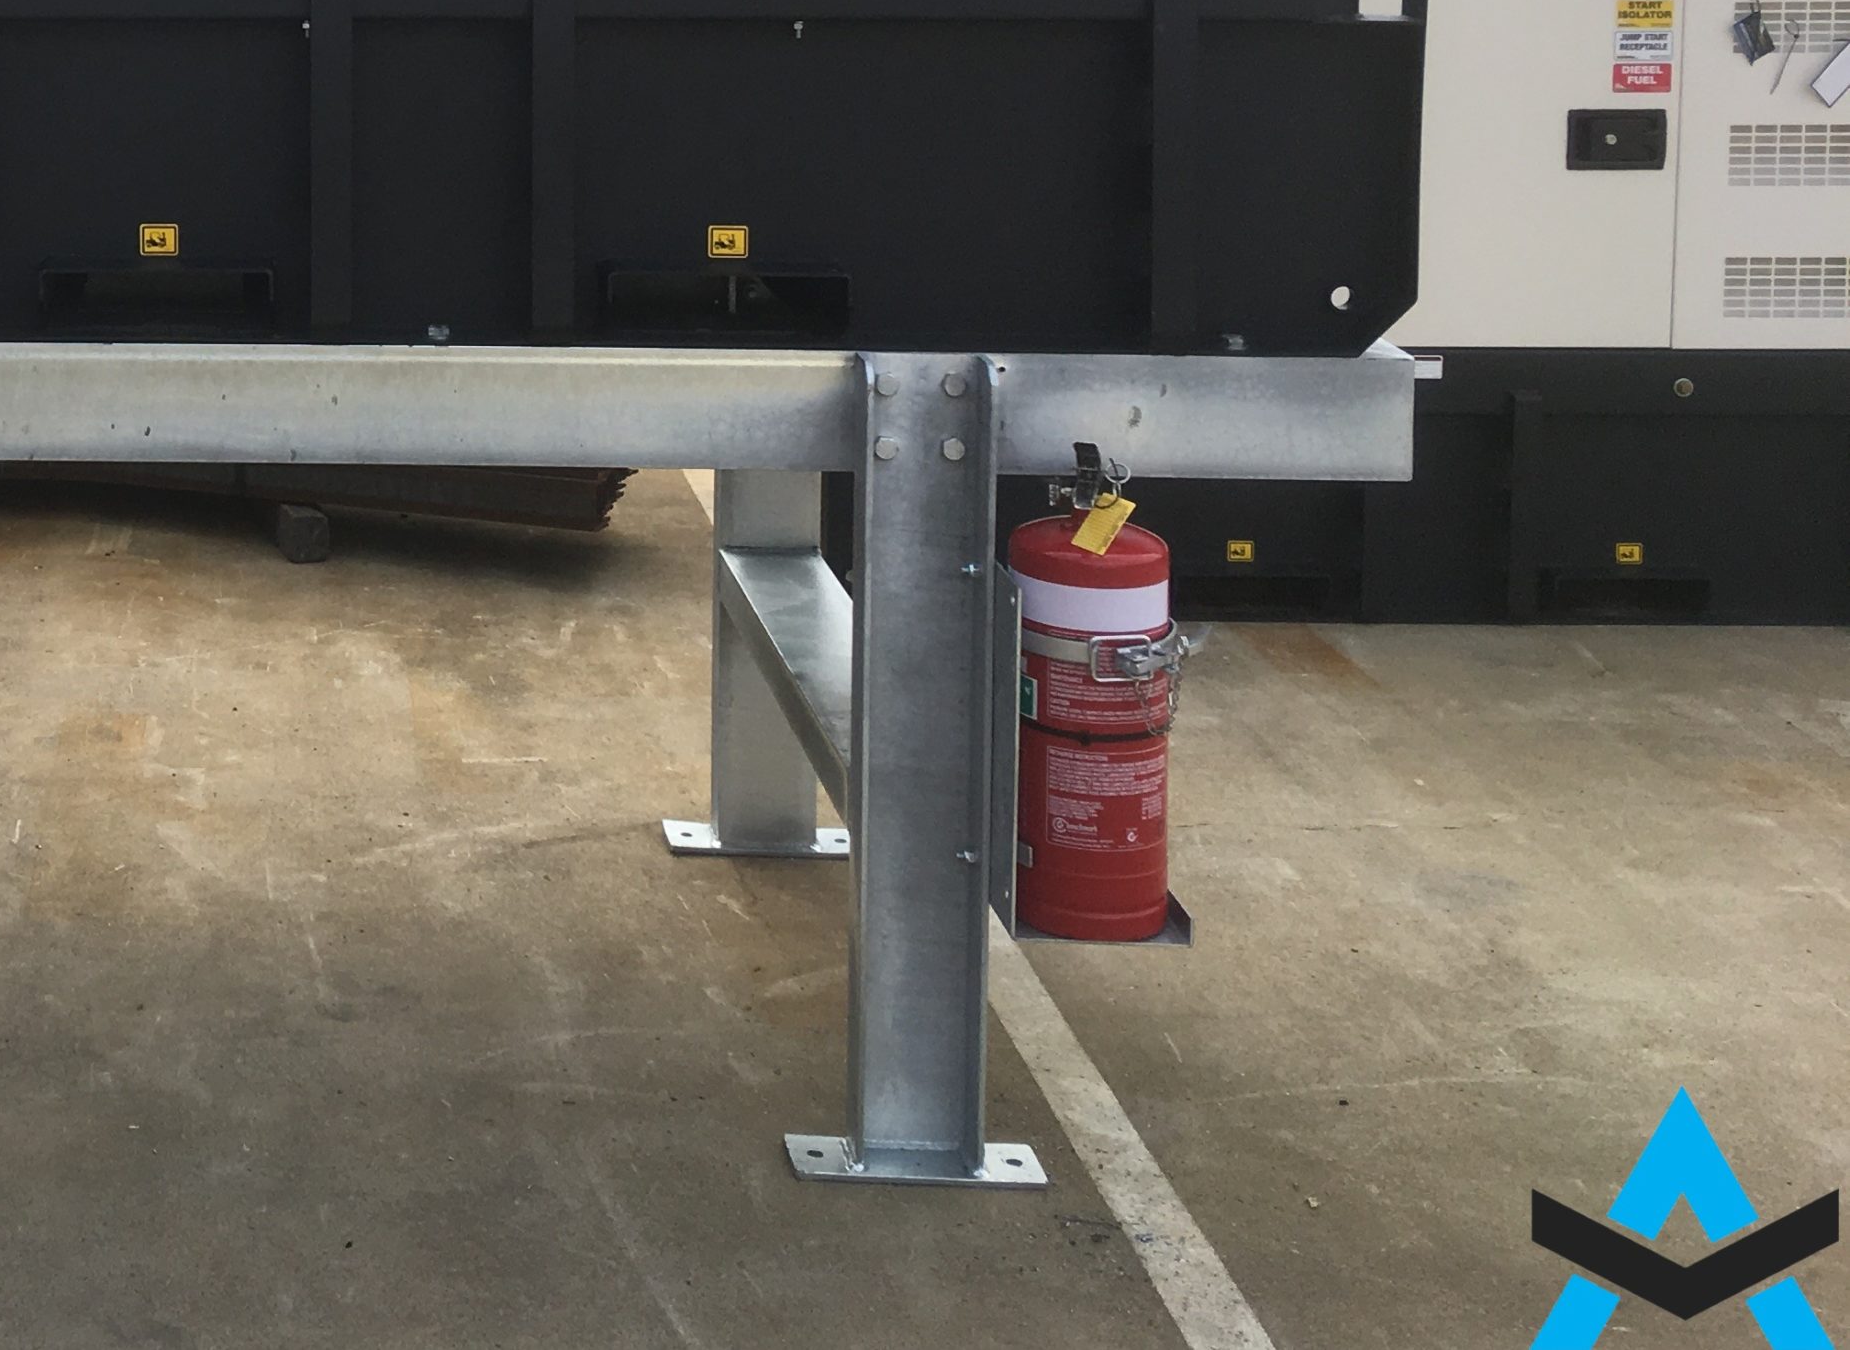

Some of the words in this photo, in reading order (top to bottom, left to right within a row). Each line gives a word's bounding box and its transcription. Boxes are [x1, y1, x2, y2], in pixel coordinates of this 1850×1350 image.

[1628, 1, 1663, 10] START
[1617, 10, 1672, 19] ISOLATOR
[1620, 33, 1642, 41] JUMP
[1644, 33, 1669, 41] START
[1619, 43, 1668, 51] RECEPTACLE
[1622, 65, 1664, 75] DIESEL
[1627, 75, 1658, 85] FUEL
